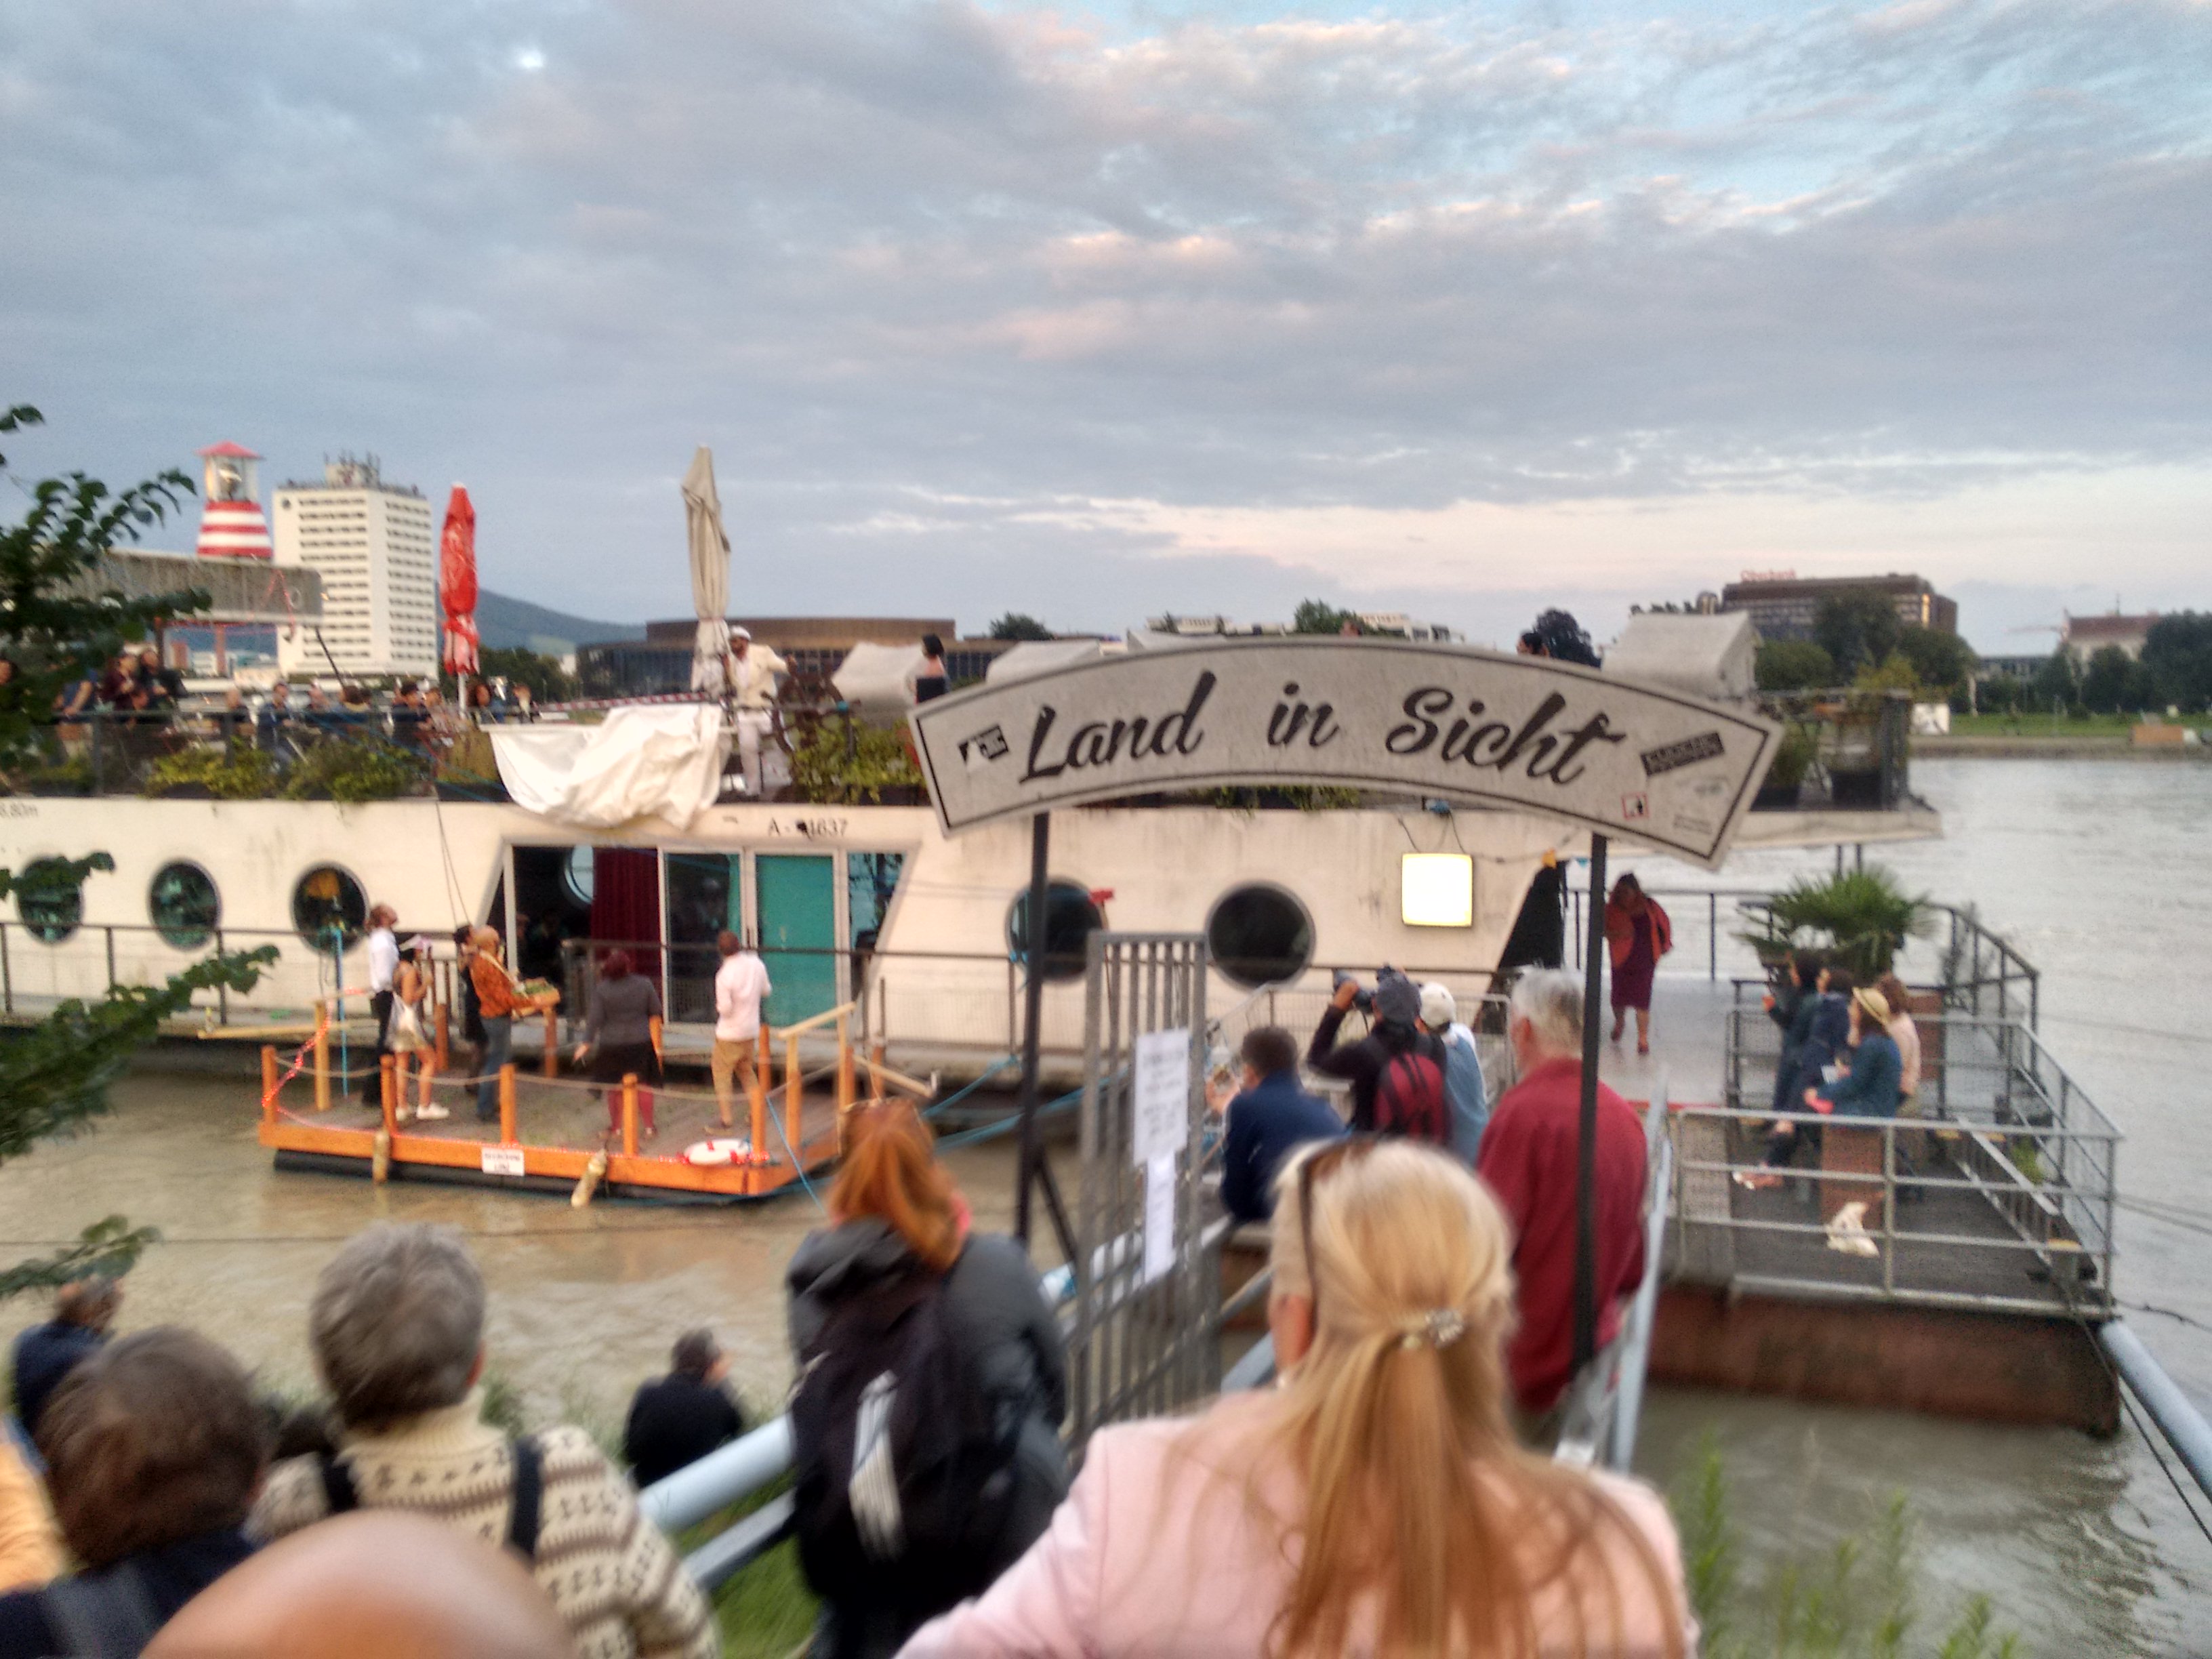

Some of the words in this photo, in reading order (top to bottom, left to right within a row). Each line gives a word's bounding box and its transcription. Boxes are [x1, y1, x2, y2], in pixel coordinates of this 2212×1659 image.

[1019, 669, 1218, 784] Land
[1266, 682, 1340, 748] in
[1384, 686, 1628, 786] Sicht
